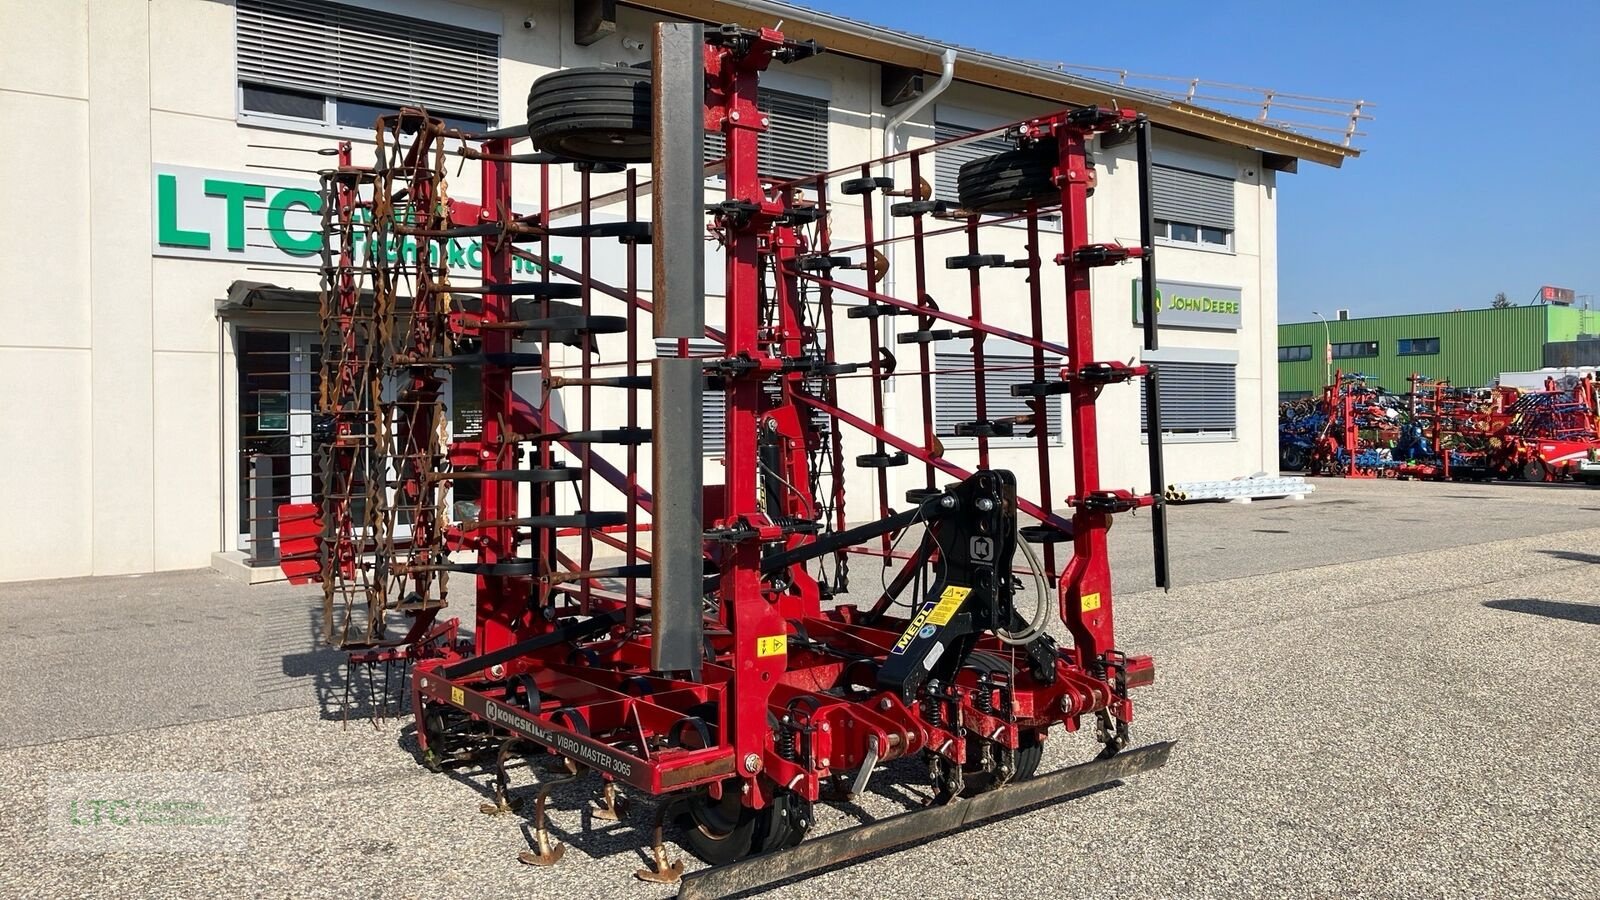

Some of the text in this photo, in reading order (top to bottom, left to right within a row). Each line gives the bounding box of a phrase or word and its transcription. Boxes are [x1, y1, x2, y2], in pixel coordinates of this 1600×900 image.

[157, 173, 324, 256] LTC
[1168, 294, 1239, 314] JOHN DEERE
[897, 607, 933, 649] MEDL
[557, 734, 579, 753] VIBRO
[580, 744, 611, 768] MASTER
[612, 759, 631, 777] 3065
